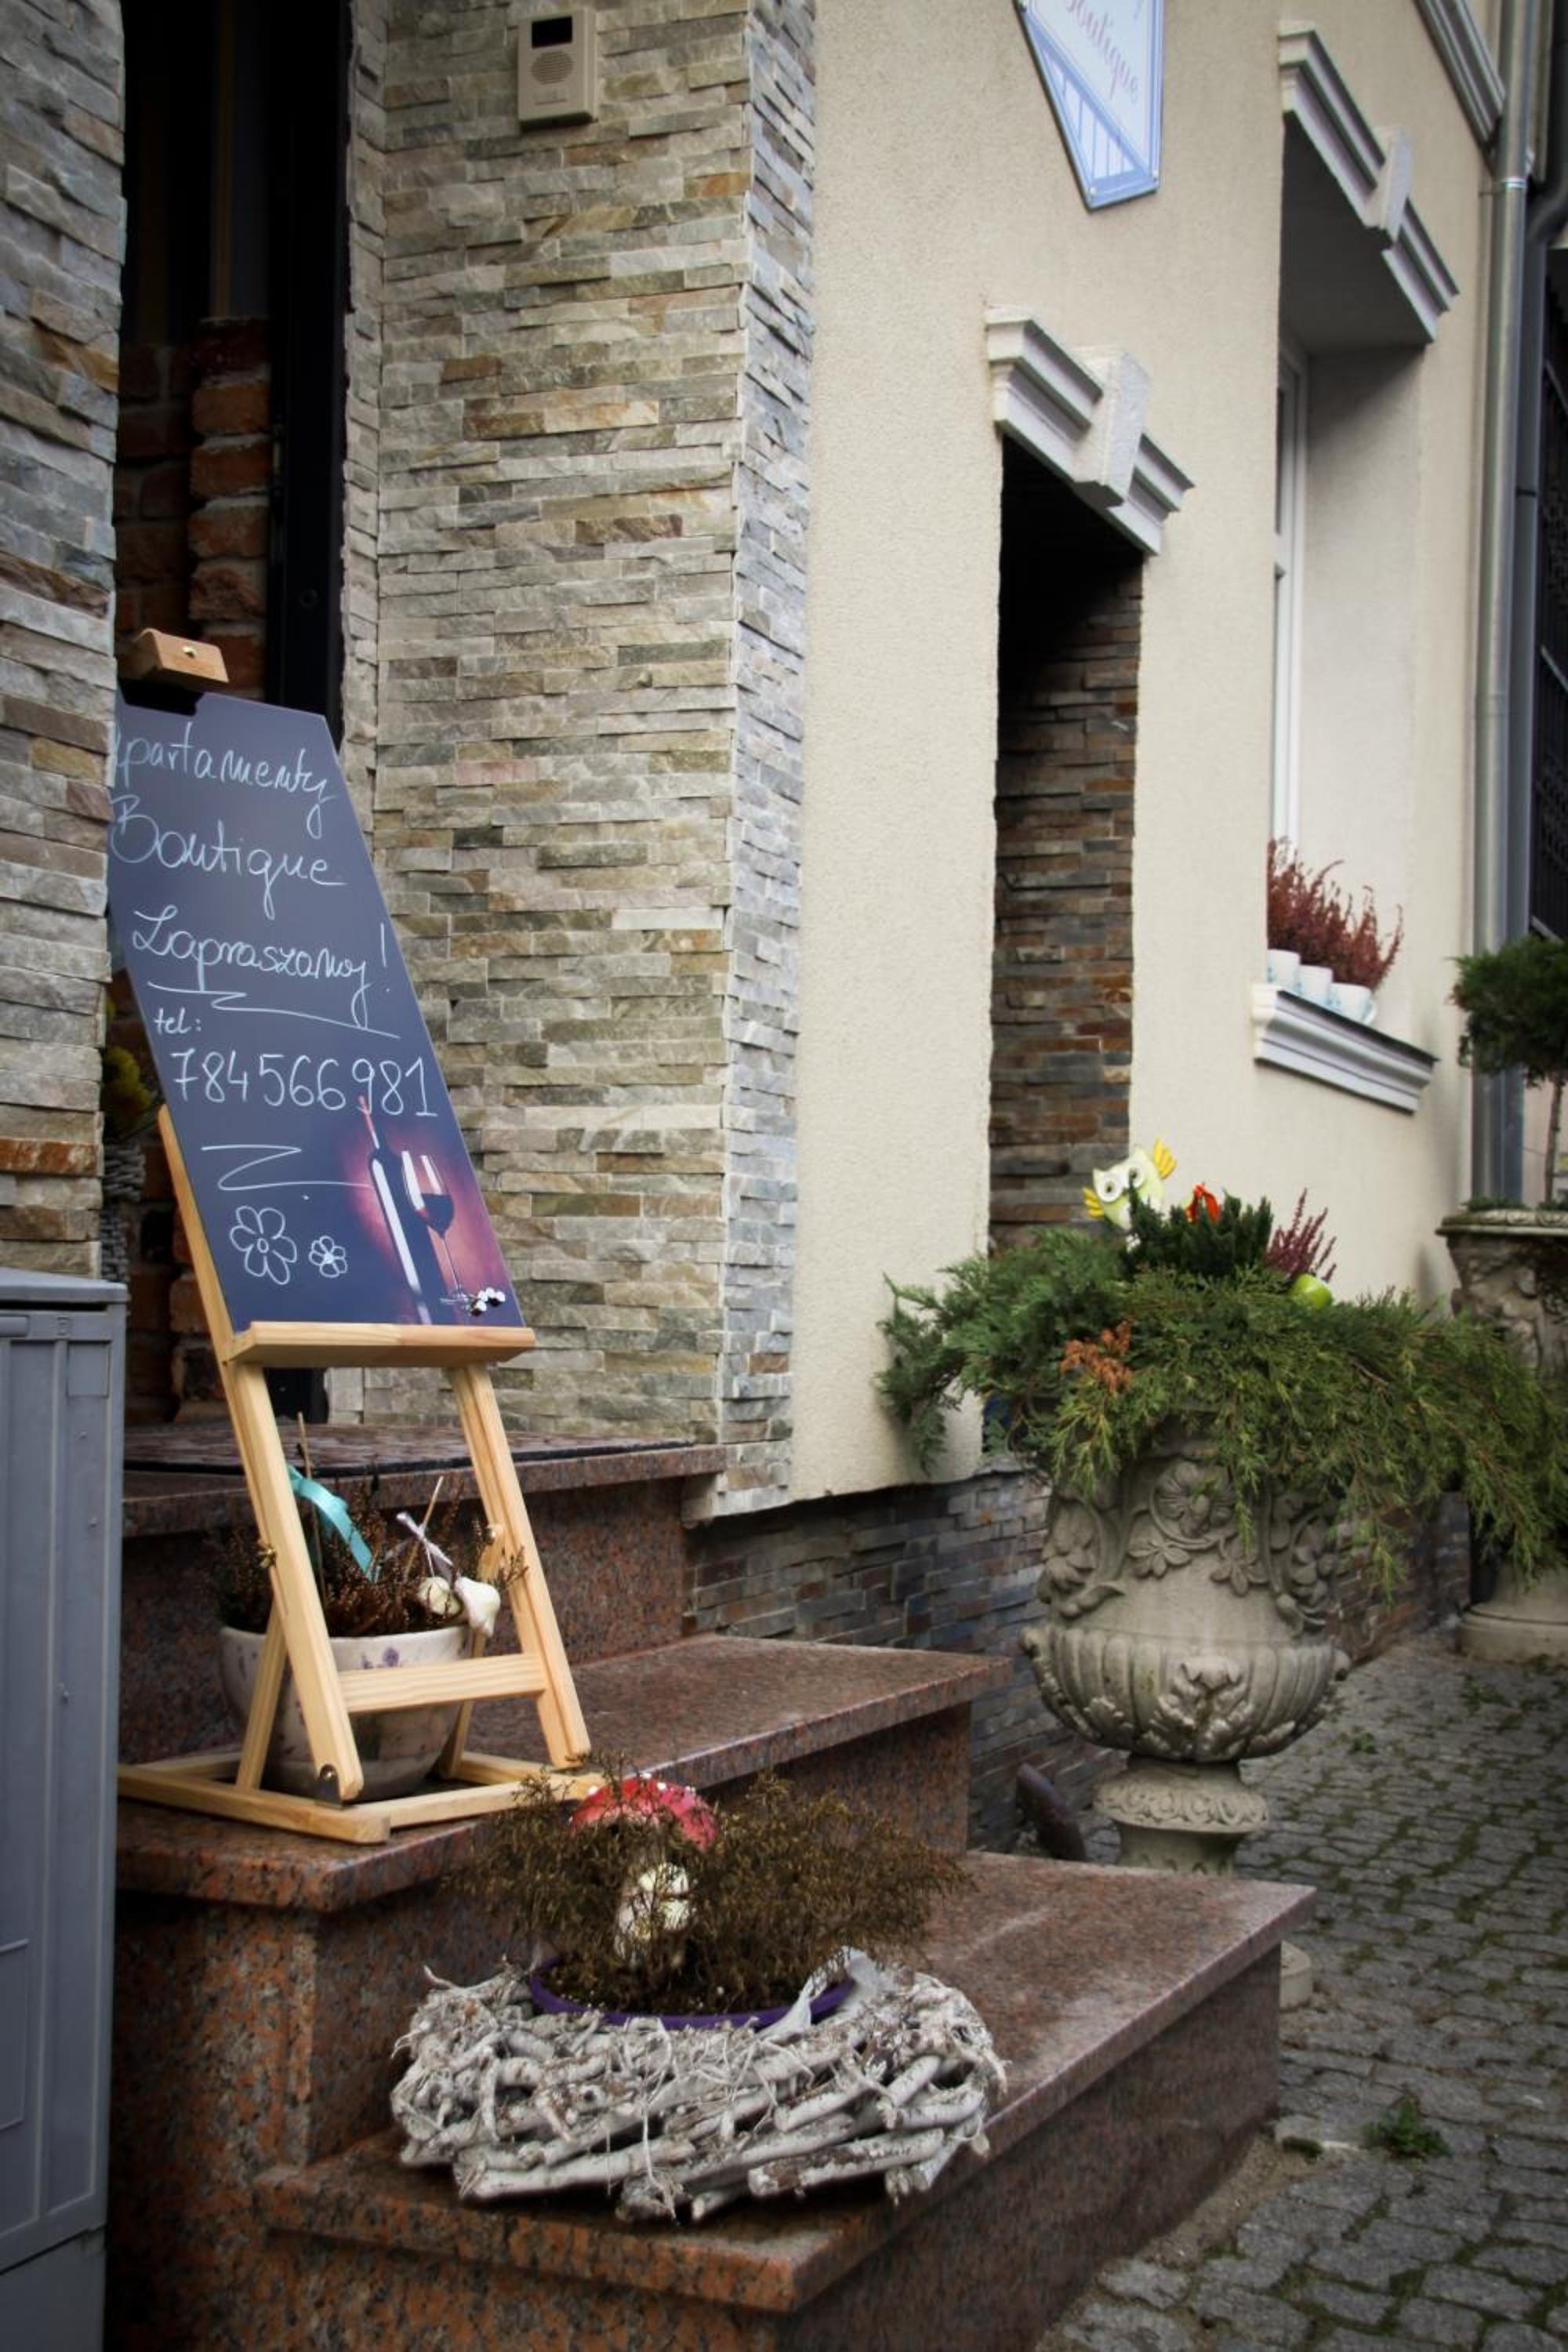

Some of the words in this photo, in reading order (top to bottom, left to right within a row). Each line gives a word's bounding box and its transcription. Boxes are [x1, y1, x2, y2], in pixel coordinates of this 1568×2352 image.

[1065, 0, 1140, 103] outique
[110, 794, 348, 920] Boutique
[154, 1007, 201, 1035] tel:
